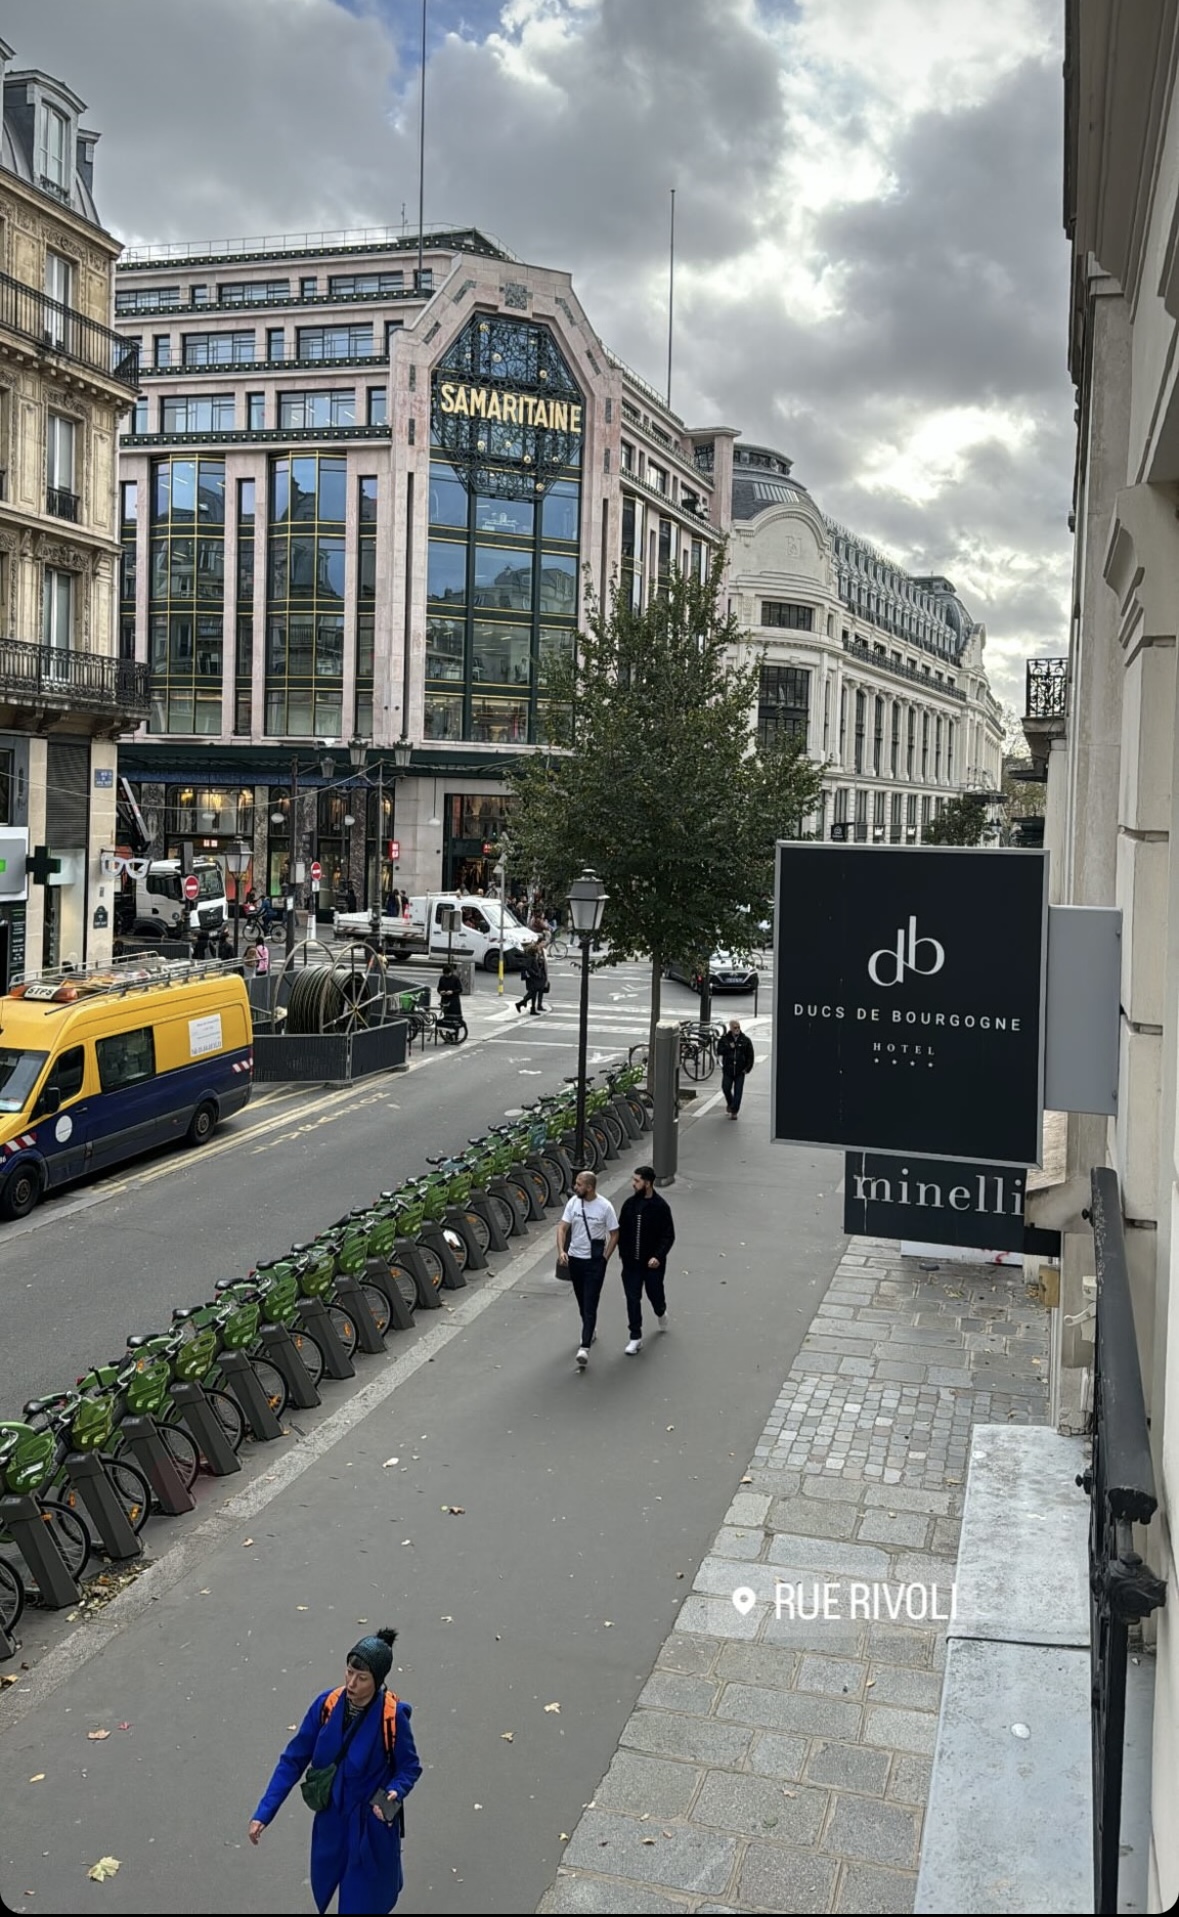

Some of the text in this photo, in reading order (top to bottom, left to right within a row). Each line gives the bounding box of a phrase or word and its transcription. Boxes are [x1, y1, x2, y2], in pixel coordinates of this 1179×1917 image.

[441, 384, 582, 433] SAMARITAINE
[867, 915, 945, 987] db
[27, 987, 55, 996] STPS
[794, 1003, 1022, 1032] DUCS DE BOURGOGNE
[872, 1042, 936, 1056] HOTEL
[852, 1168, 1025, 1217] minelli
